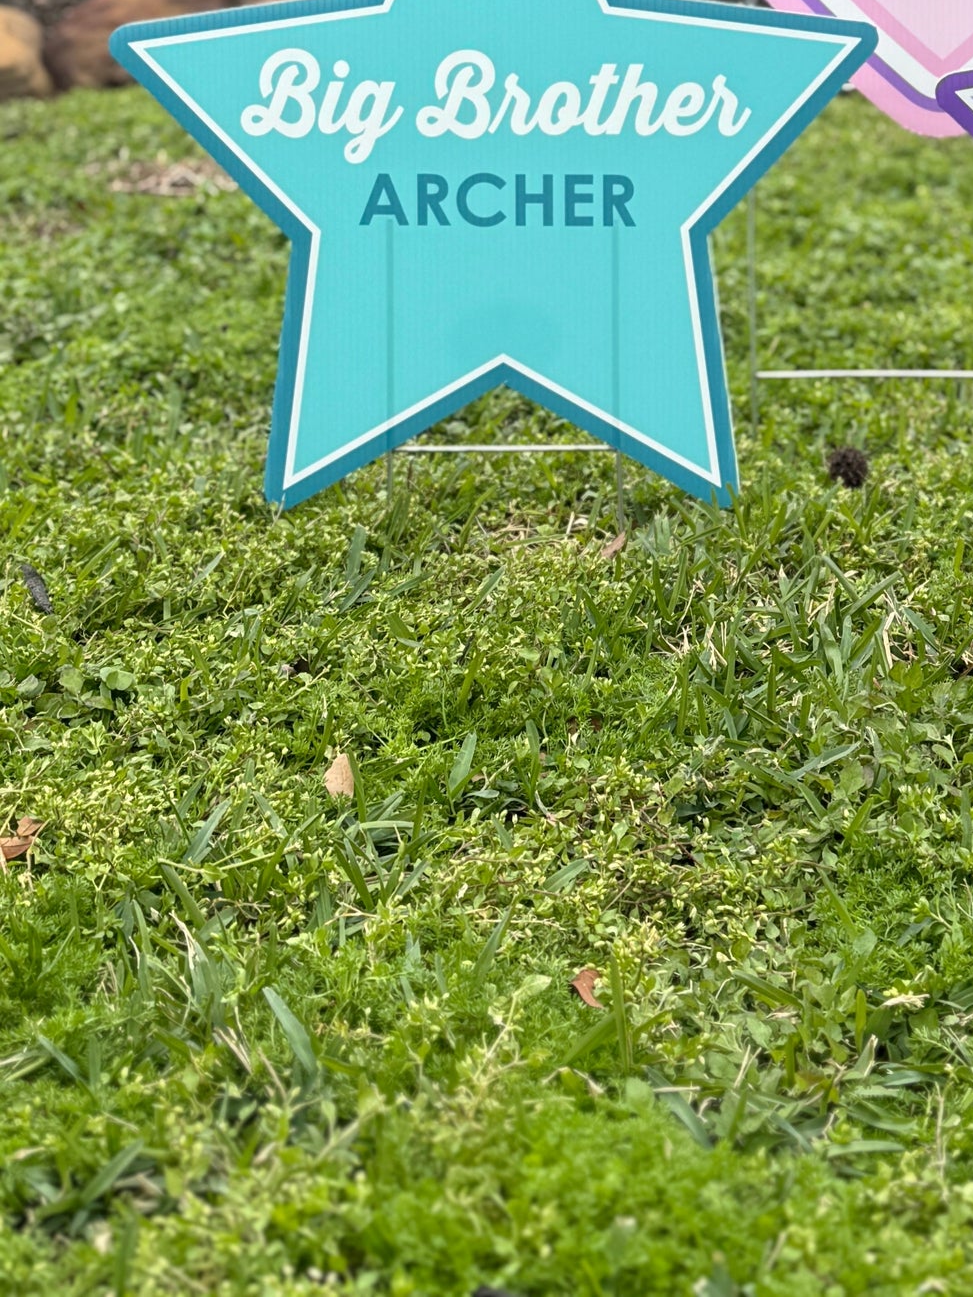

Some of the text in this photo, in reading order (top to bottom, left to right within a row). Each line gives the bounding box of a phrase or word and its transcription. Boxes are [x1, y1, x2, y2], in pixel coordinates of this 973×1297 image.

[240, 47, 752, 164] Big Brother
[359, 172, 636, 227] ARCHER
